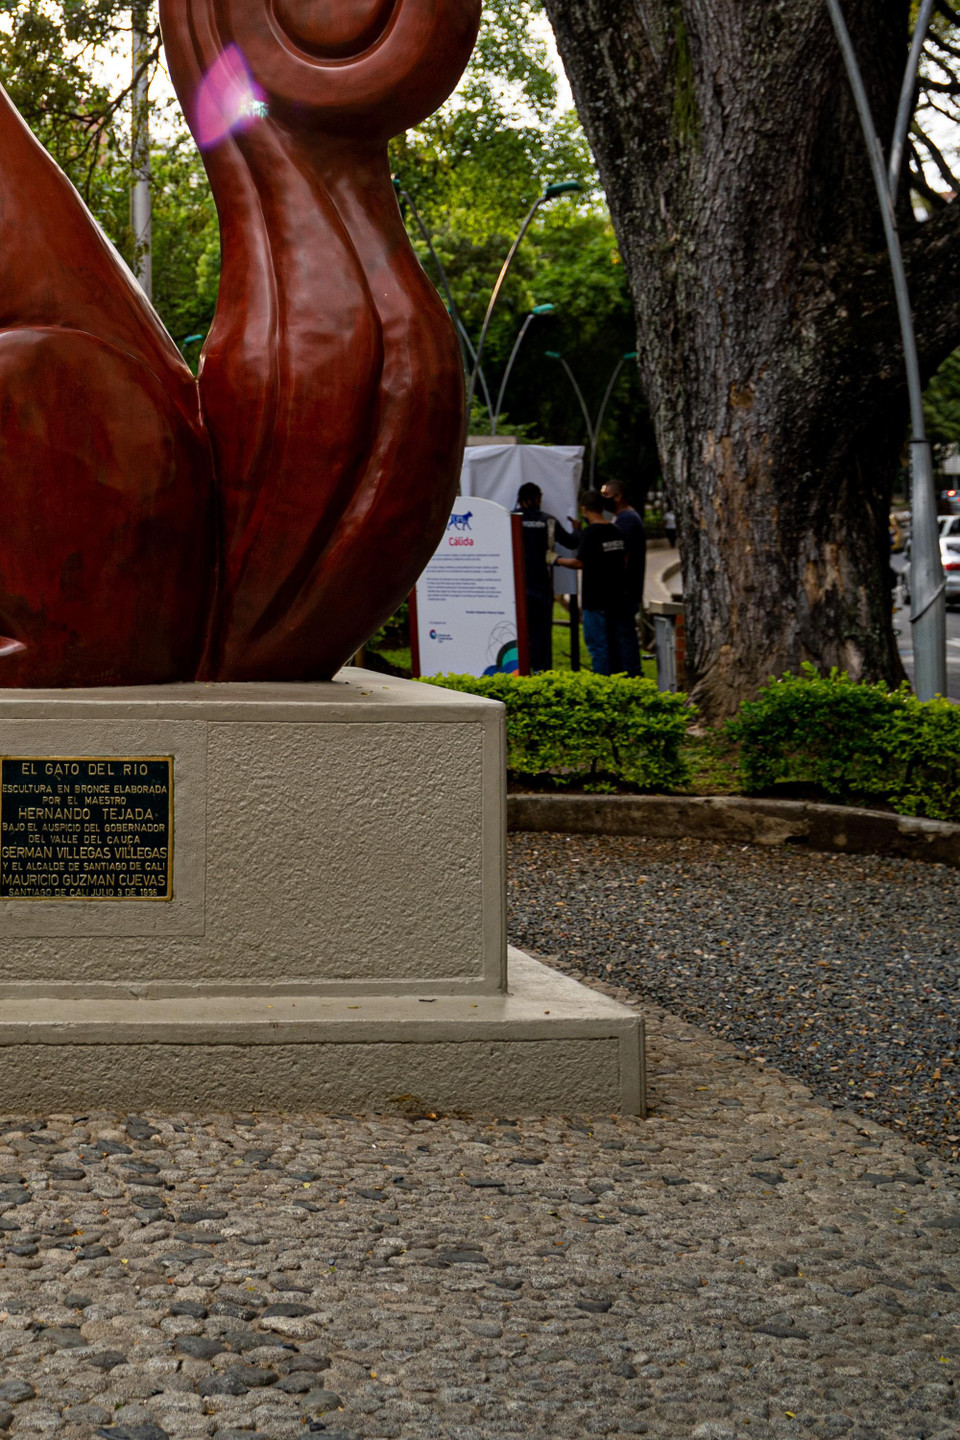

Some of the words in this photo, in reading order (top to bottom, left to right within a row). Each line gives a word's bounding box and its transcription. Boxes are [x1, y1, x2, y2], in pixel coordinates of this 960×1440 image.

[448, 536, 474, 546] Cálida
[22, 763, 37, 775] EL
[46, 763, 79, 775] GATO
[89, 764, 114, 775] DEL
[124, 764, 148, 775] RIO
[2, 784, 52, 793] ESCULTURA
[57, 785, 70, 793] EN
[75, 785, 110, 793] BRONCE
[114, 785, 167, 794] ELABORADA
[43, 796, 60, 805] POR
[68, 796, 78, 805] EL
[85, 797, 126, 805] MAESTRO
[19, 808, 90, 819] HERNANDO
[103, 808, 153, 820] TEJADA
[2, 823, 25, 831] BAJO
[28, 823, 37, 831] EL
[42, 823, 81, 832] AUSPICIO
[84, 824, 100, 832] DEL
[104, 824, 165, 832] GOBERNADOR
[29, 835, 45, 843] DEL
[50, 835, 78, 843] VALLE
[84, 835, 102, 844] DEL
[107, 836, 140, 844] CAUCA
[2, 847, 52, 858] GERMAN
[57, 847, 110, 858] VILLEGAS
[114, 847, 167, 859] VILLEGAS
[3, 862, 8, 870] Y
[12, 862, 22, 870] EL
[26, 862, 64, 870] ALCALDE
[69, 862, 79, 870] DE
[84, 862, 127, 870] SANTIAGO
[130, 862, 141, 870] DE
[146, 862, 165, 870] CALI
[2, 874, 59, 886] MAURICIO
[63, 874, 114, 886] GUZMAN
[119, 874, 165, 886] CUEVAS
[9, 888, 52, 896] SANTIAGO
[54, 888, 66, 896] DE
[70, 888, 89, 896] CALI
[91, 888, 113, 896] JULIO
[117, 888, 122, 896] 3
[125, 888, 137, 896] DE
